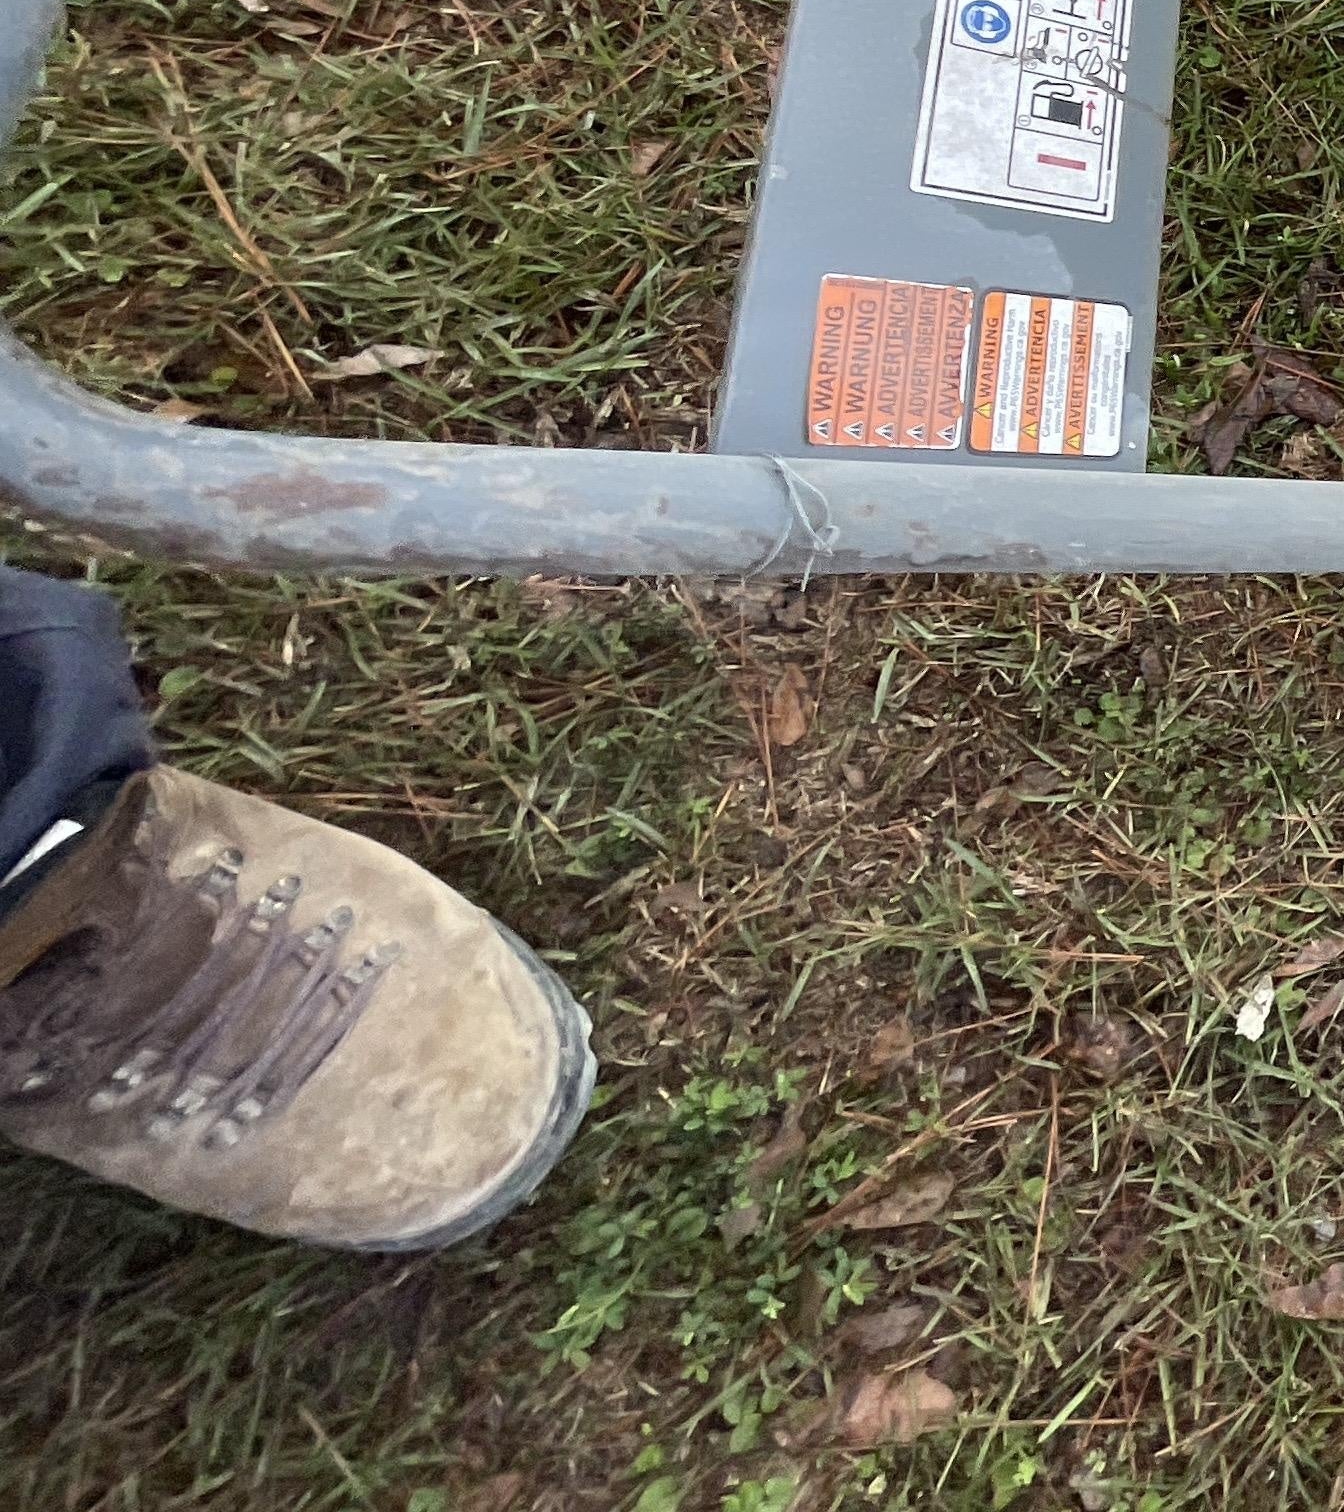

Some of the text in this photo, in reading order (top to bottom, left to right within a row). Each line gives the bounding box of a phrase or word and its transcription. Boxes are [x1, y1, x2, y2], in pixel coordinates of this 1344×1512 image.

[813, 306, 845, 411] WARNING
[845, 299, 877, 413] WARNUNG
[878, 287, 910, 416] ADVERTENCIA
[938, 292, 965, 418] AVVERTENZA
[978, 317, 999, 398] WARNING
[1026, 309, 1047, 417] ADVERTENCIA
[1069, 304, 1091, 429] AVERTISSEMENT
